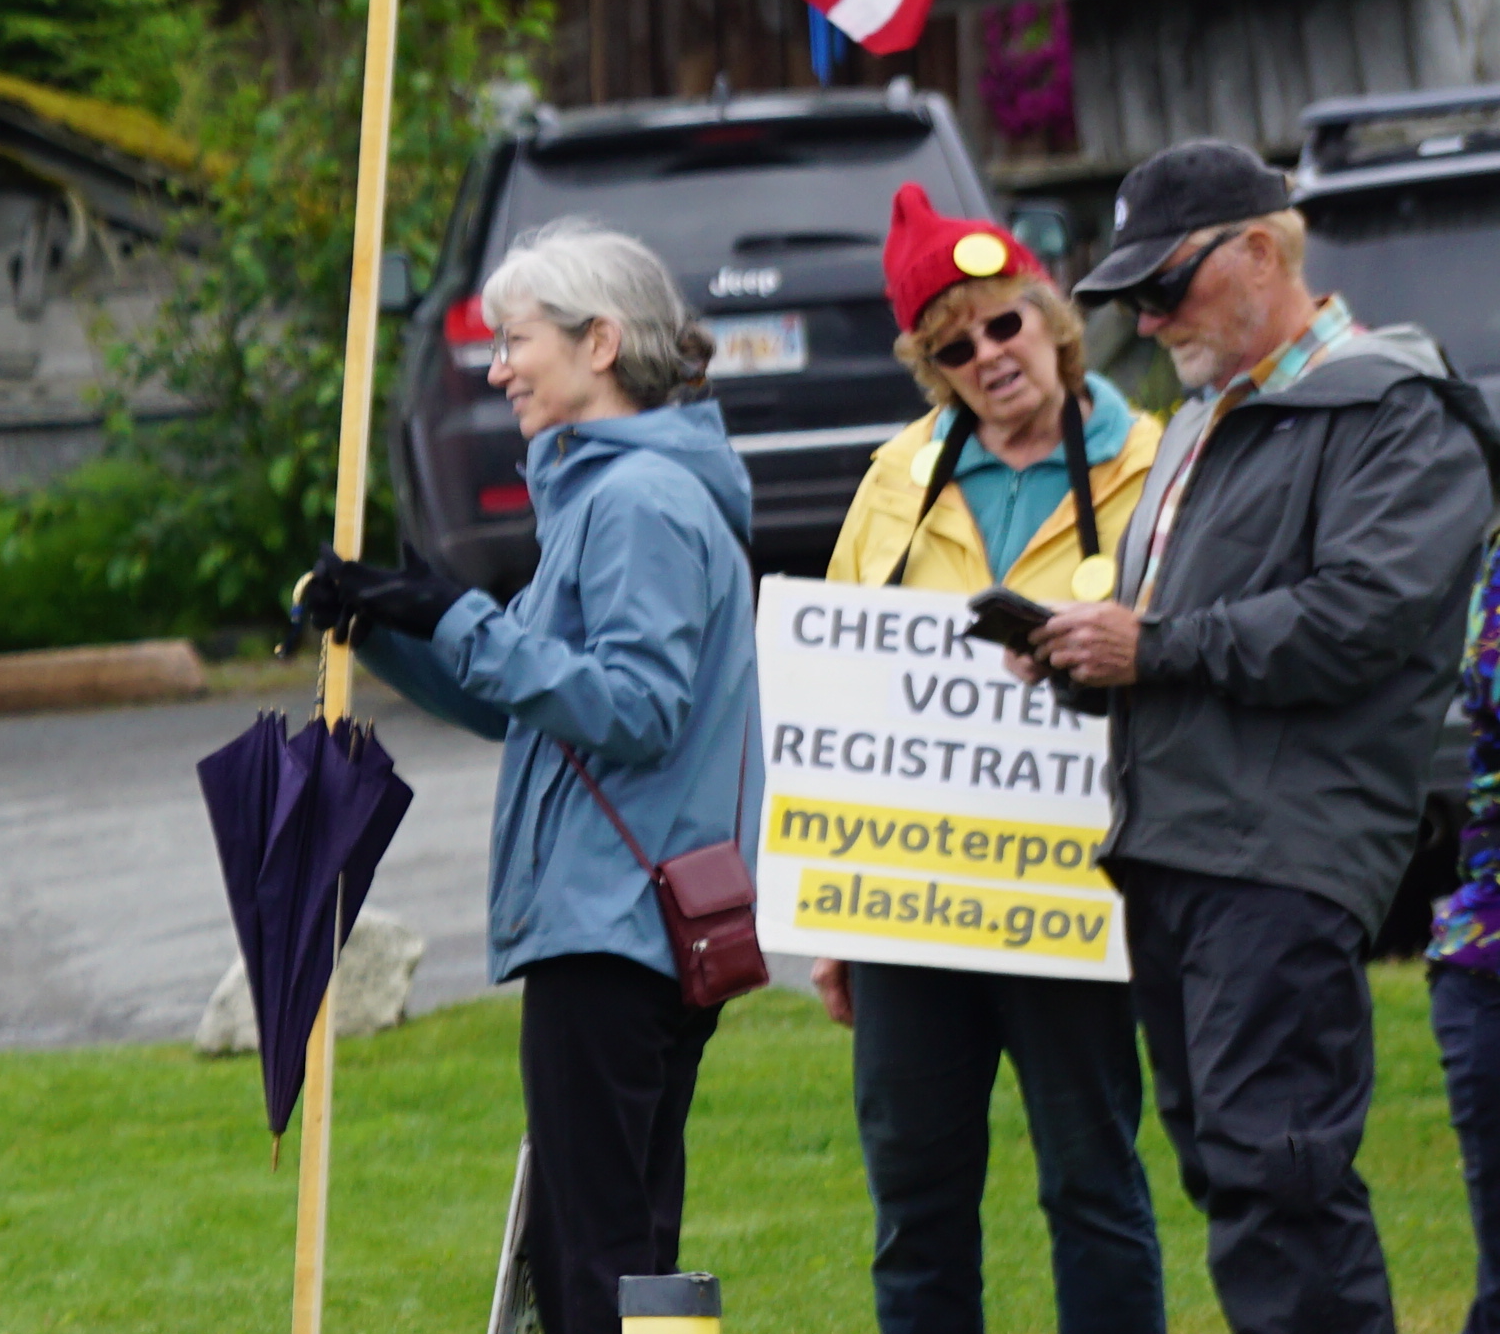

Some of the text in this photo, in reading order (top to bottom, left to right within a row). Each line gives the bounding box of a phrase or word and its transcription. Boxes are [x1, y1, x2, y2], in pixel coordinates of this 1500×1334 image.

[708, 265, 781, 298] Jeep
[791, 605, 975, 660] CHECK
[771, 723, 1111, 798] REGISTRATI
[797, 873, 1106, 947] .alaska.gov
